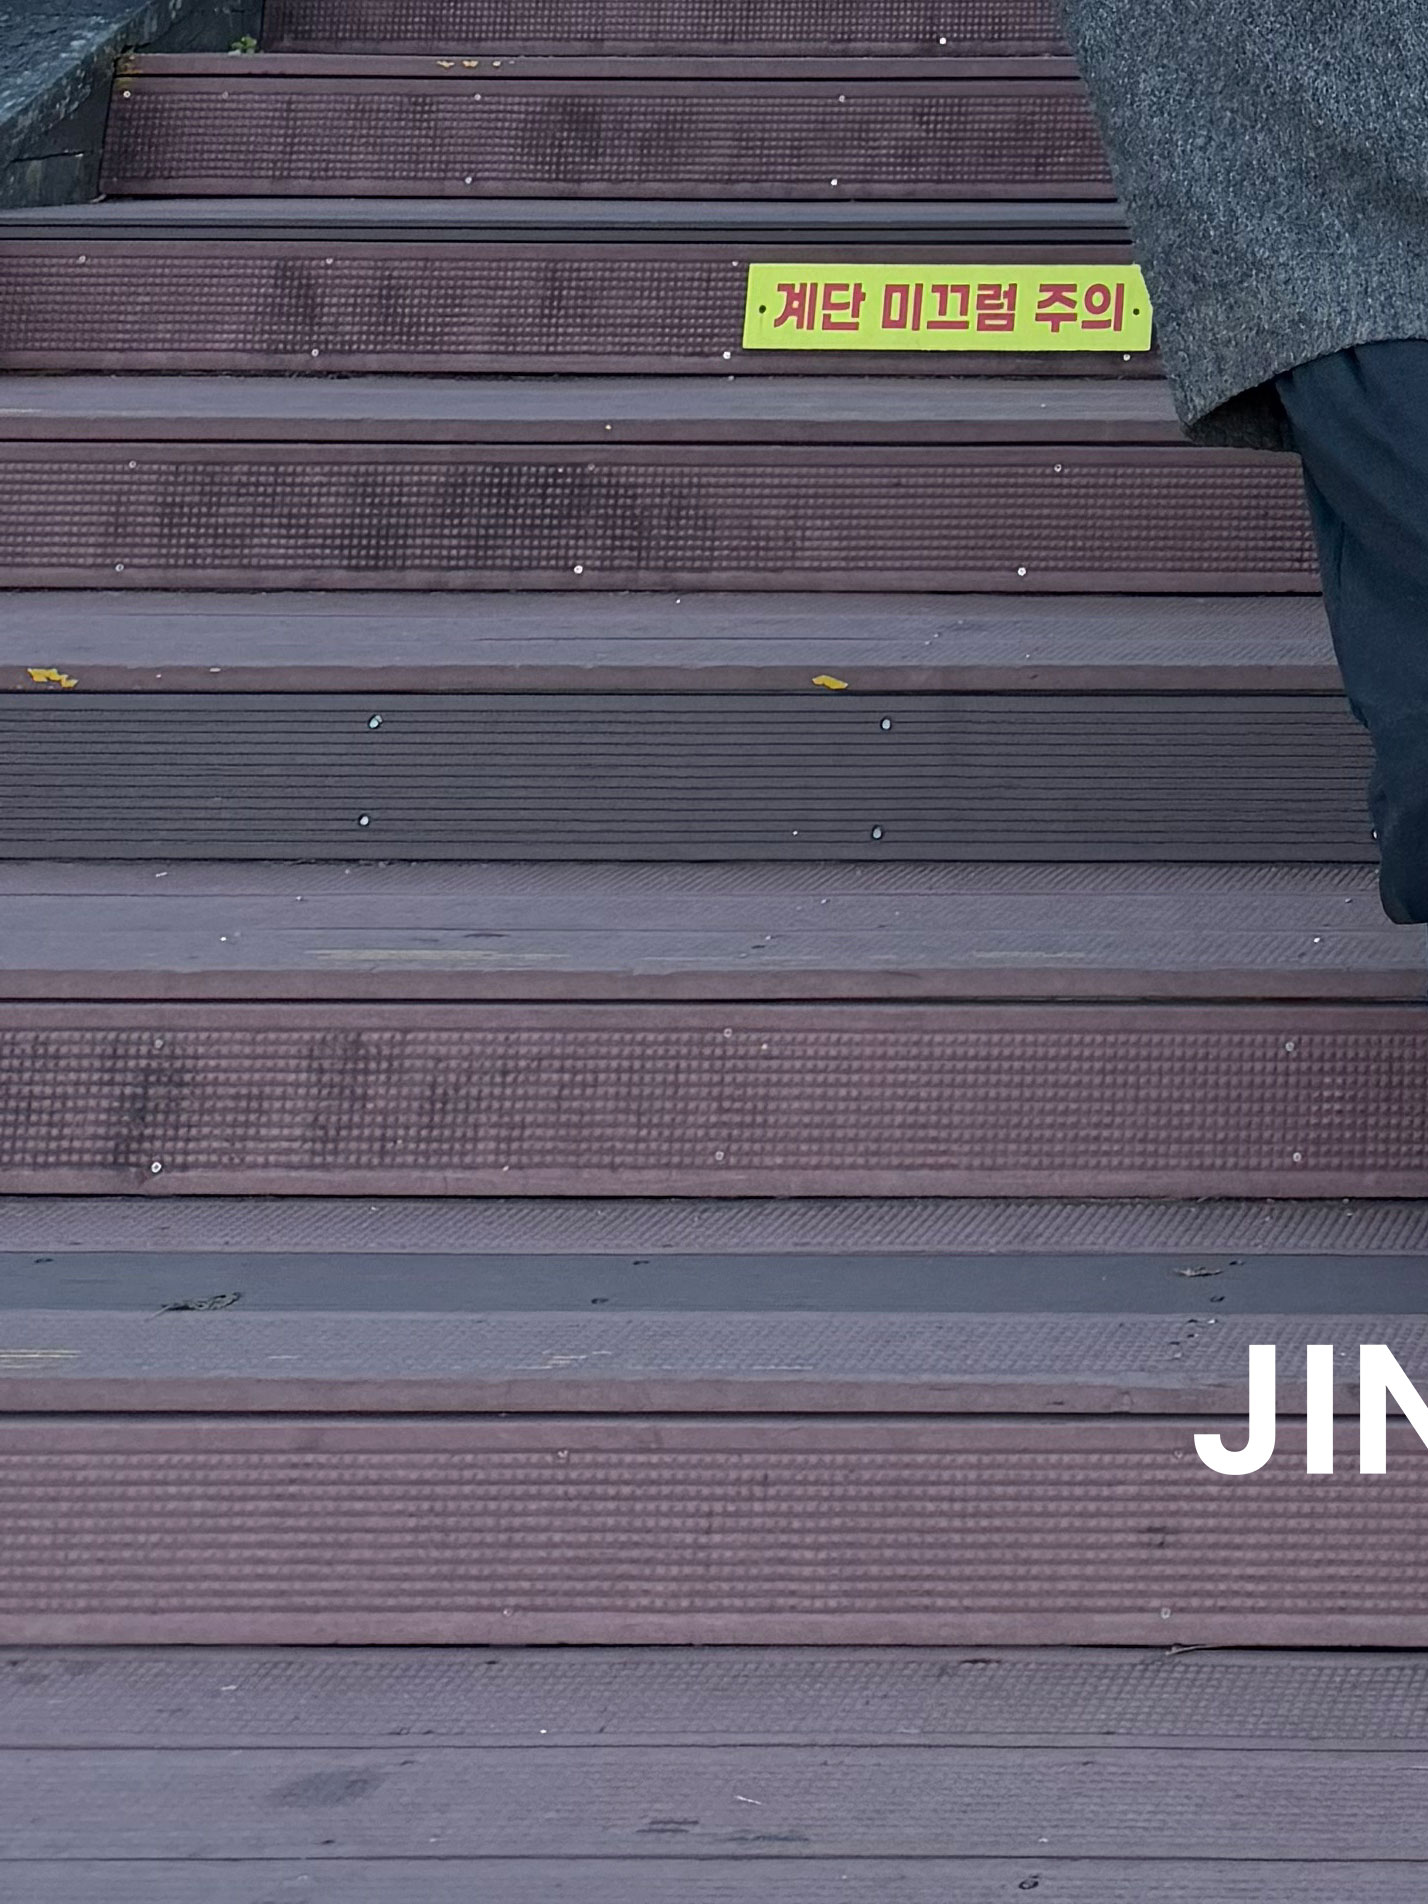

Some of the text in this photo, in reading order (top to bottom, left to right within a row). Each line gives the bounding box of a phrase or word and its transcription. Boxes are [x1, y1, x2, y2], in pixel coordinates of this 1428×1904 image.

[773, 282, 1126, 333] 계단 미끄럼 주의
